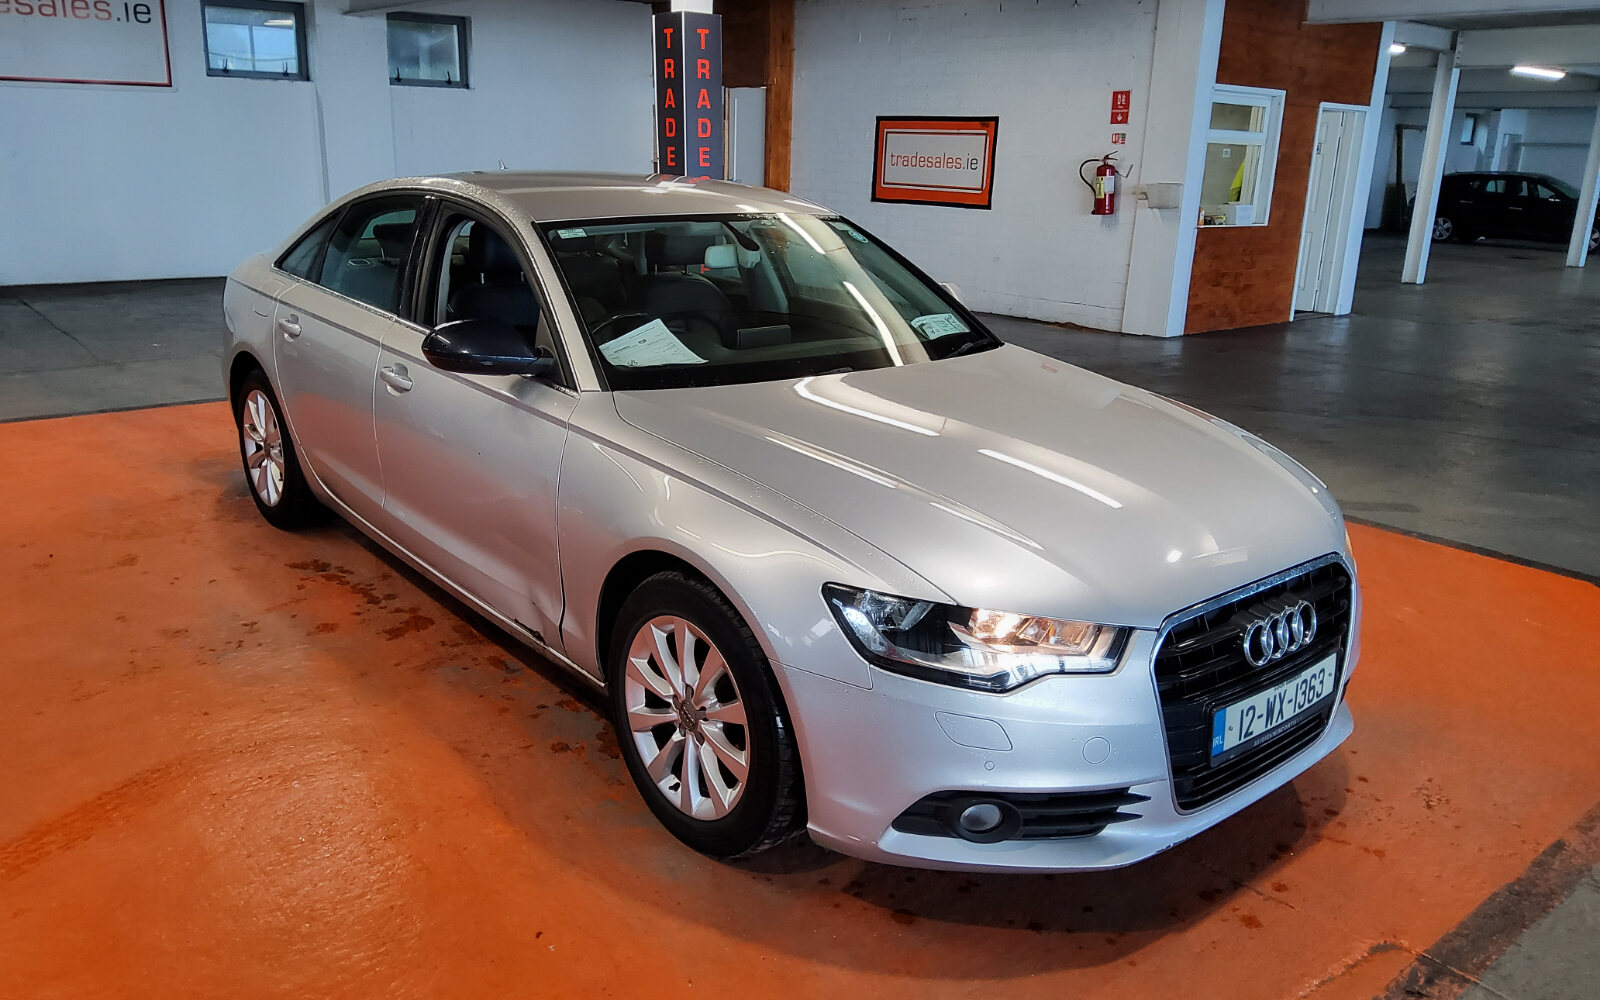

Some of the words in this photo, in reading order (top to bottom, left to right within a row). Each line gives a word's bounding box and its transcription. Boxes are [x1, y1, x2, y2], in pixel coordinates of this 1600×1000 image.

[663, 27, 676, 166] TRADE
[696, 28, 712, 180] TRADE
[890, 151, 979, 171] tradesales.ie
[1212, 734, 1224, 748] IRL
[1238, 667, 1326, 742] 12-WX-1363
